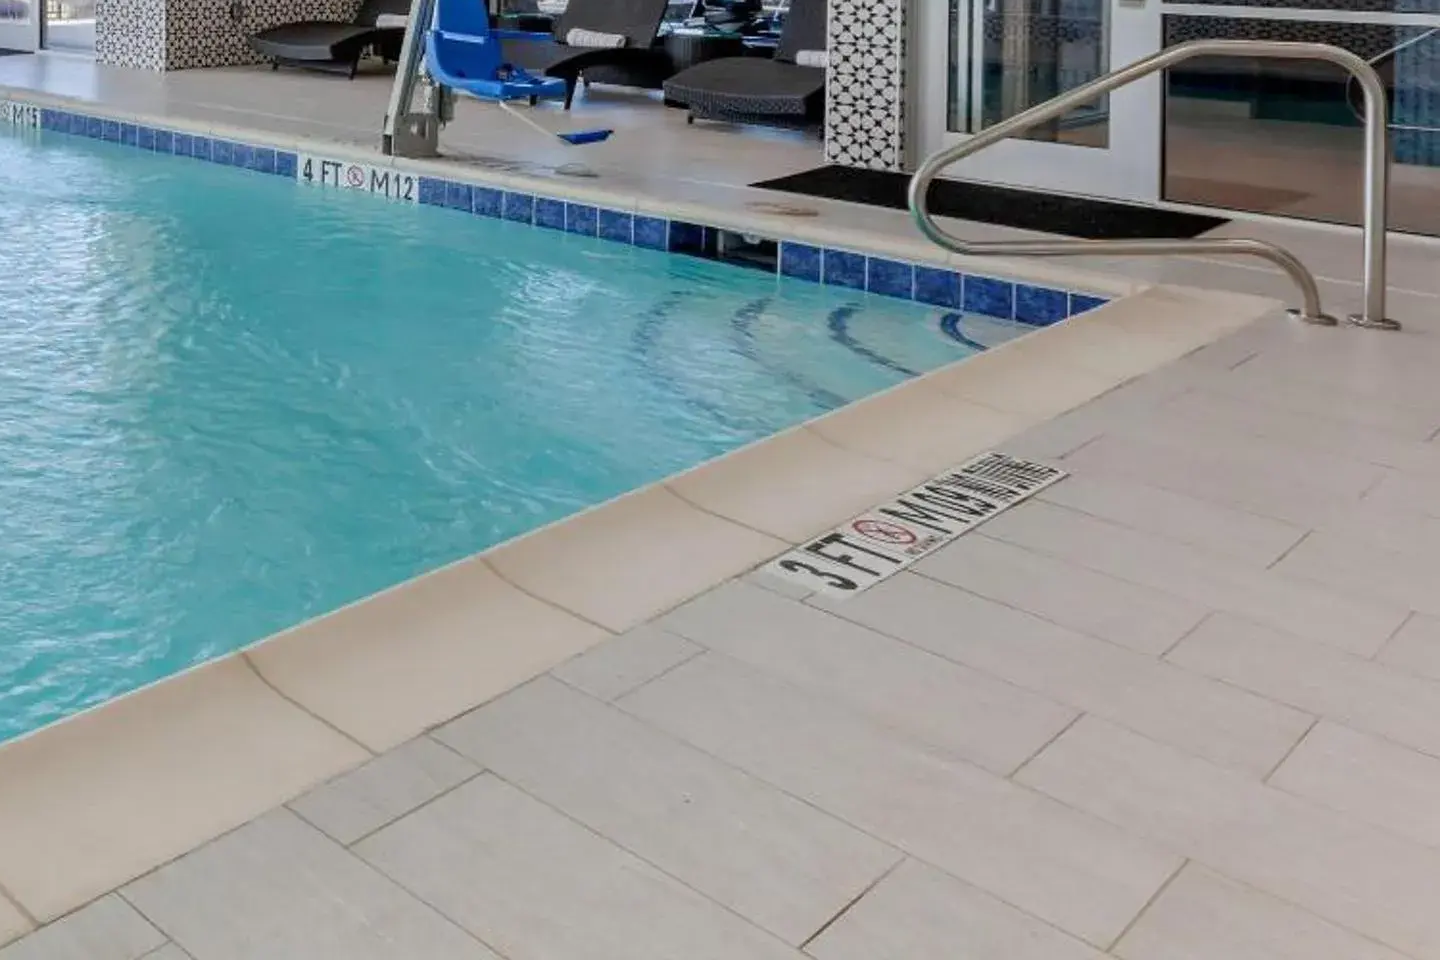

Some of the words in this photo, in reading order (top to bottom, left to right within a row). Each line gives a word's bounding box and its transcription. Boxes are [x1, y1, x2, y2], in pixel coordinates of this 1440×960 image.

[303, 158, 313, 182] 4
[321, 160, 342, 187] FT
[805, 532, 902, 577] FT
[779, 559, 858, 591] 3
